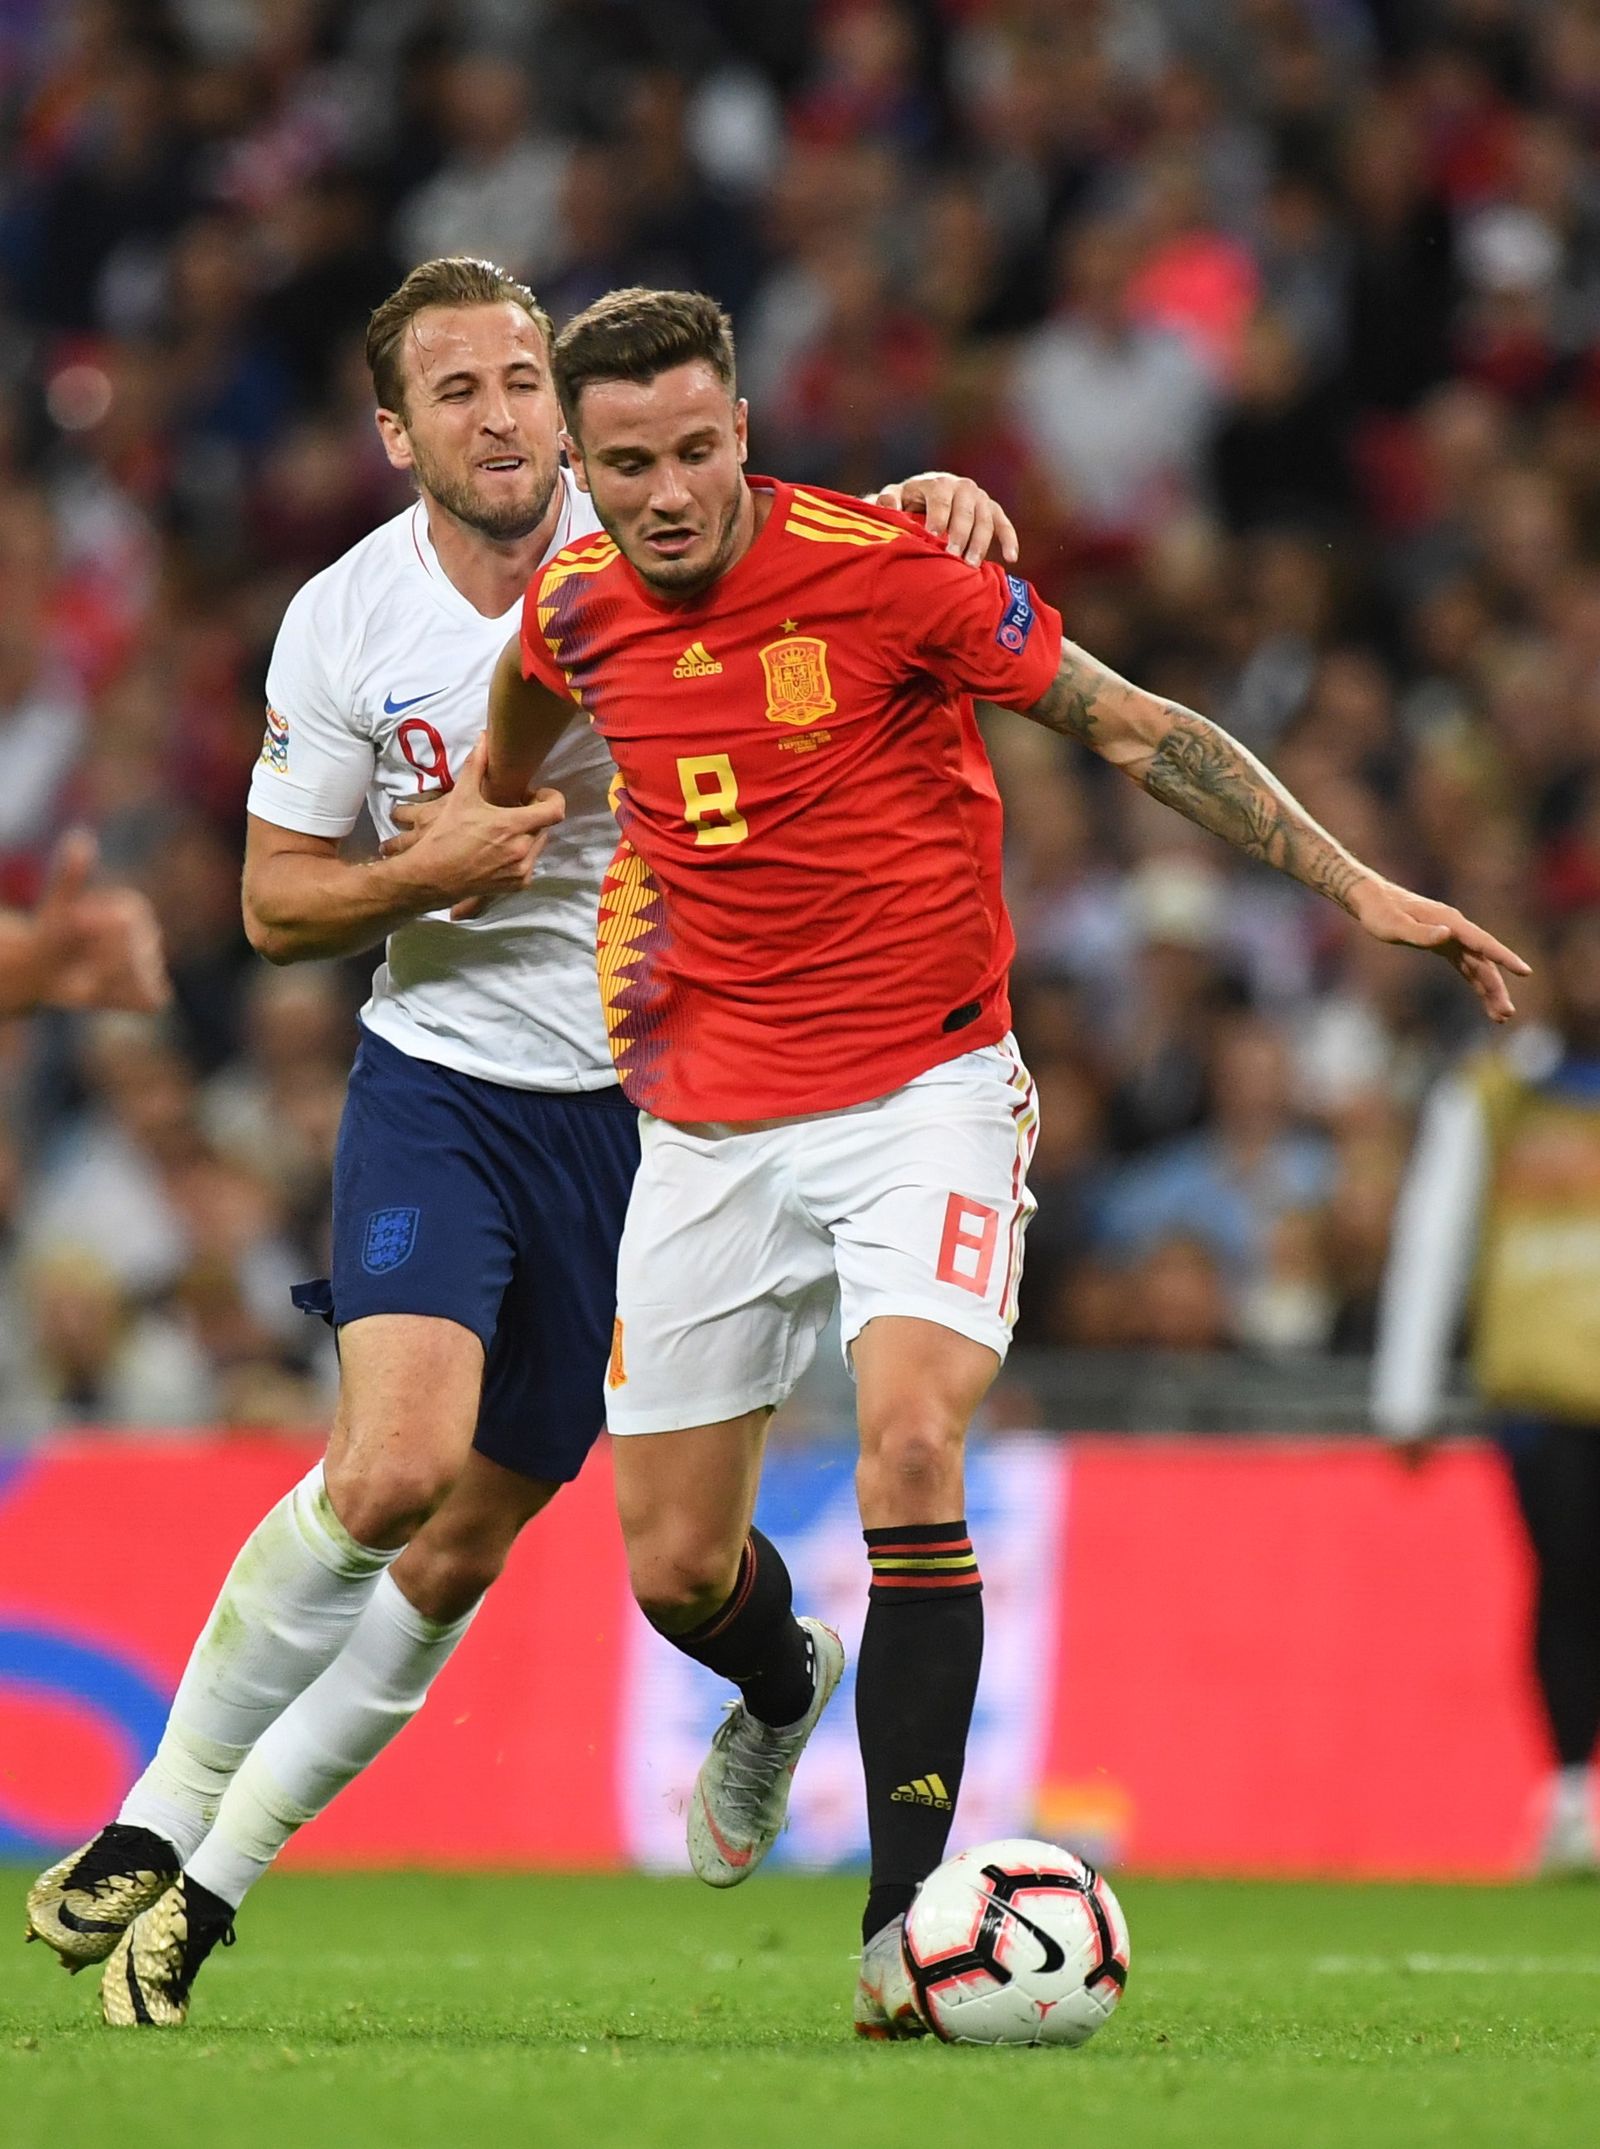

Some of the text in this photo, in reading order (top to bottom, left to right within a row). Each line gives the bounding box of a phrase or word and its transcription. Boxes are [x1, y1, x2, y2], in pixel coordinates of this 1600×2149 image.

[673, 662, 723, 678] adidas
[397, 718, 455, 793] 9
[676, 753, 749, 845] 8
[936, 1191, 999, 1298] 8
[891, 1791, 951, 1810] adidas
